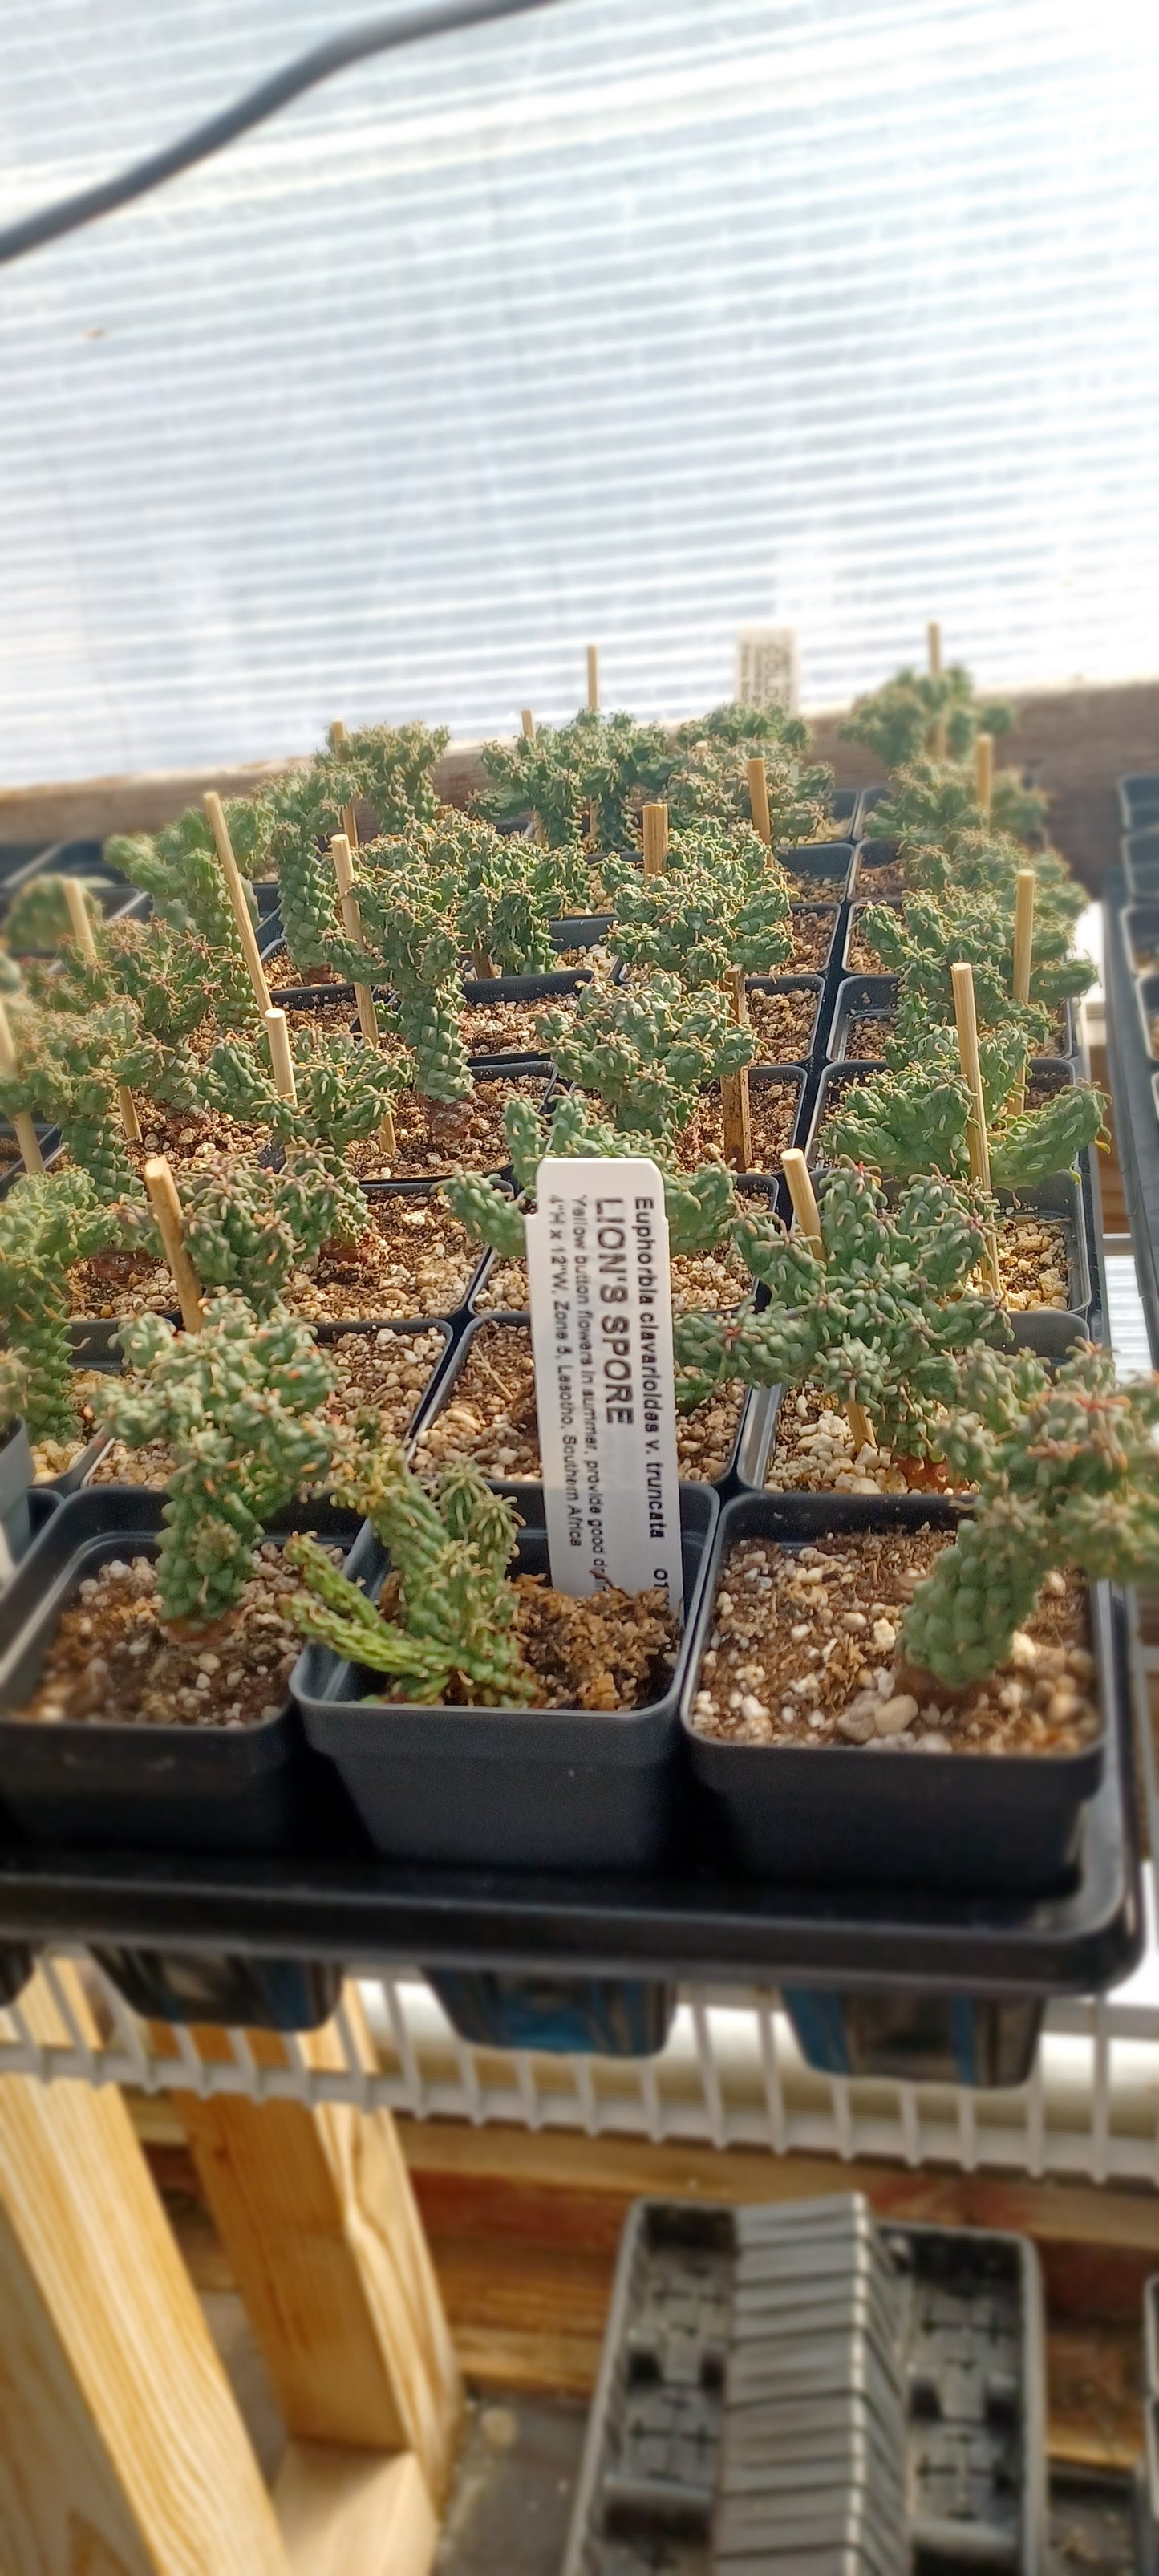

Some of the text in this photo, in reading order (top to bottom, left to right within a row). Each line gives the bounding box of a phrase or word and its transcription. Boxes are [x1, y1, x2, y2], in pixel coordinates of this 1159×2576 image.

[549, 1195, 566, 1224] 4"H
[573, 1195, 587, 1249] Yellow
[550, 1230, 563, 1239] x
[631, 1197, 659, 1304] Euphorbia
[575, 1255, 593, 1304] button
[553, 1300, 570, 1340] Zone
[596, 1198, 635, 1424] LION'S SPORE
[577, 1310, 595, 1365] flowers
[582, 1371, 597, 1383] in
[562, 1435, 581, 1501] Southern
[645, 1439, 660, 1454] v.
[584, 1460, 603, 1514] provide
[646, 1462, 667, 1538] truncata
[566, 1505, 583, 1546] Africa
[587, 1519, 606, 1554] good
